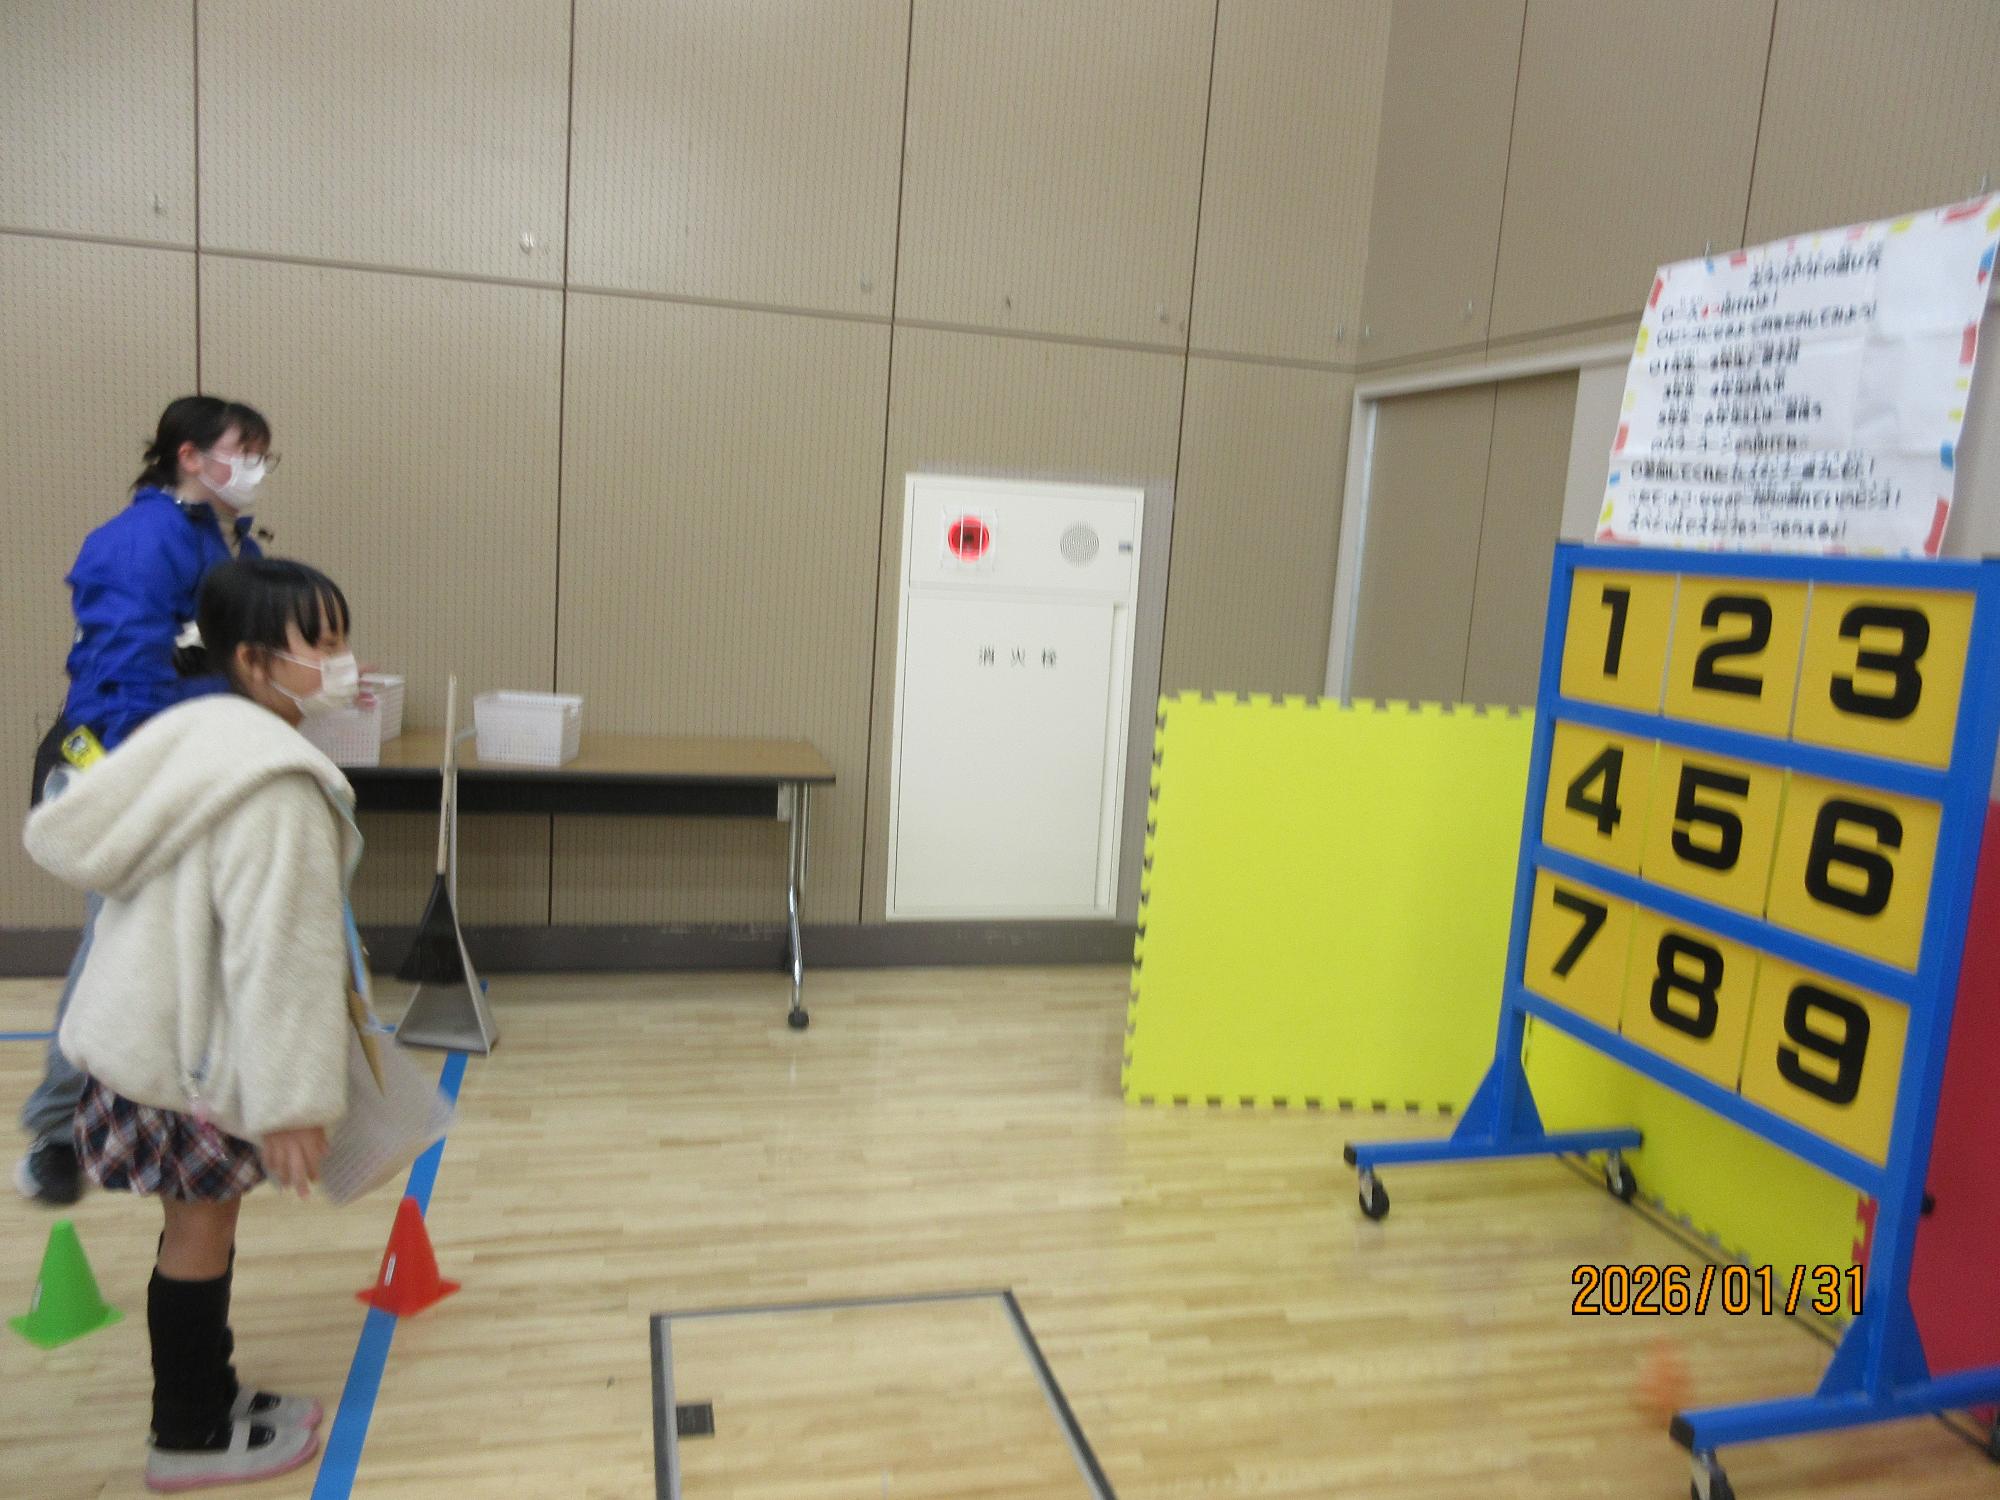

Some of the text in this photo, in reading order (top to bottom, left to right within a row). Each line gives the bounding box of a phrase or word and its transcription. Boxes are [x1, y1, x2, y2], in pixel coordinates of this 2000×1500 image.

[1601, 588, 1931, 721] 1 2 3
[1565, 747, 1904, 918] 4 5 6
[1553, 888, 1871, 1106] 7 8 9
